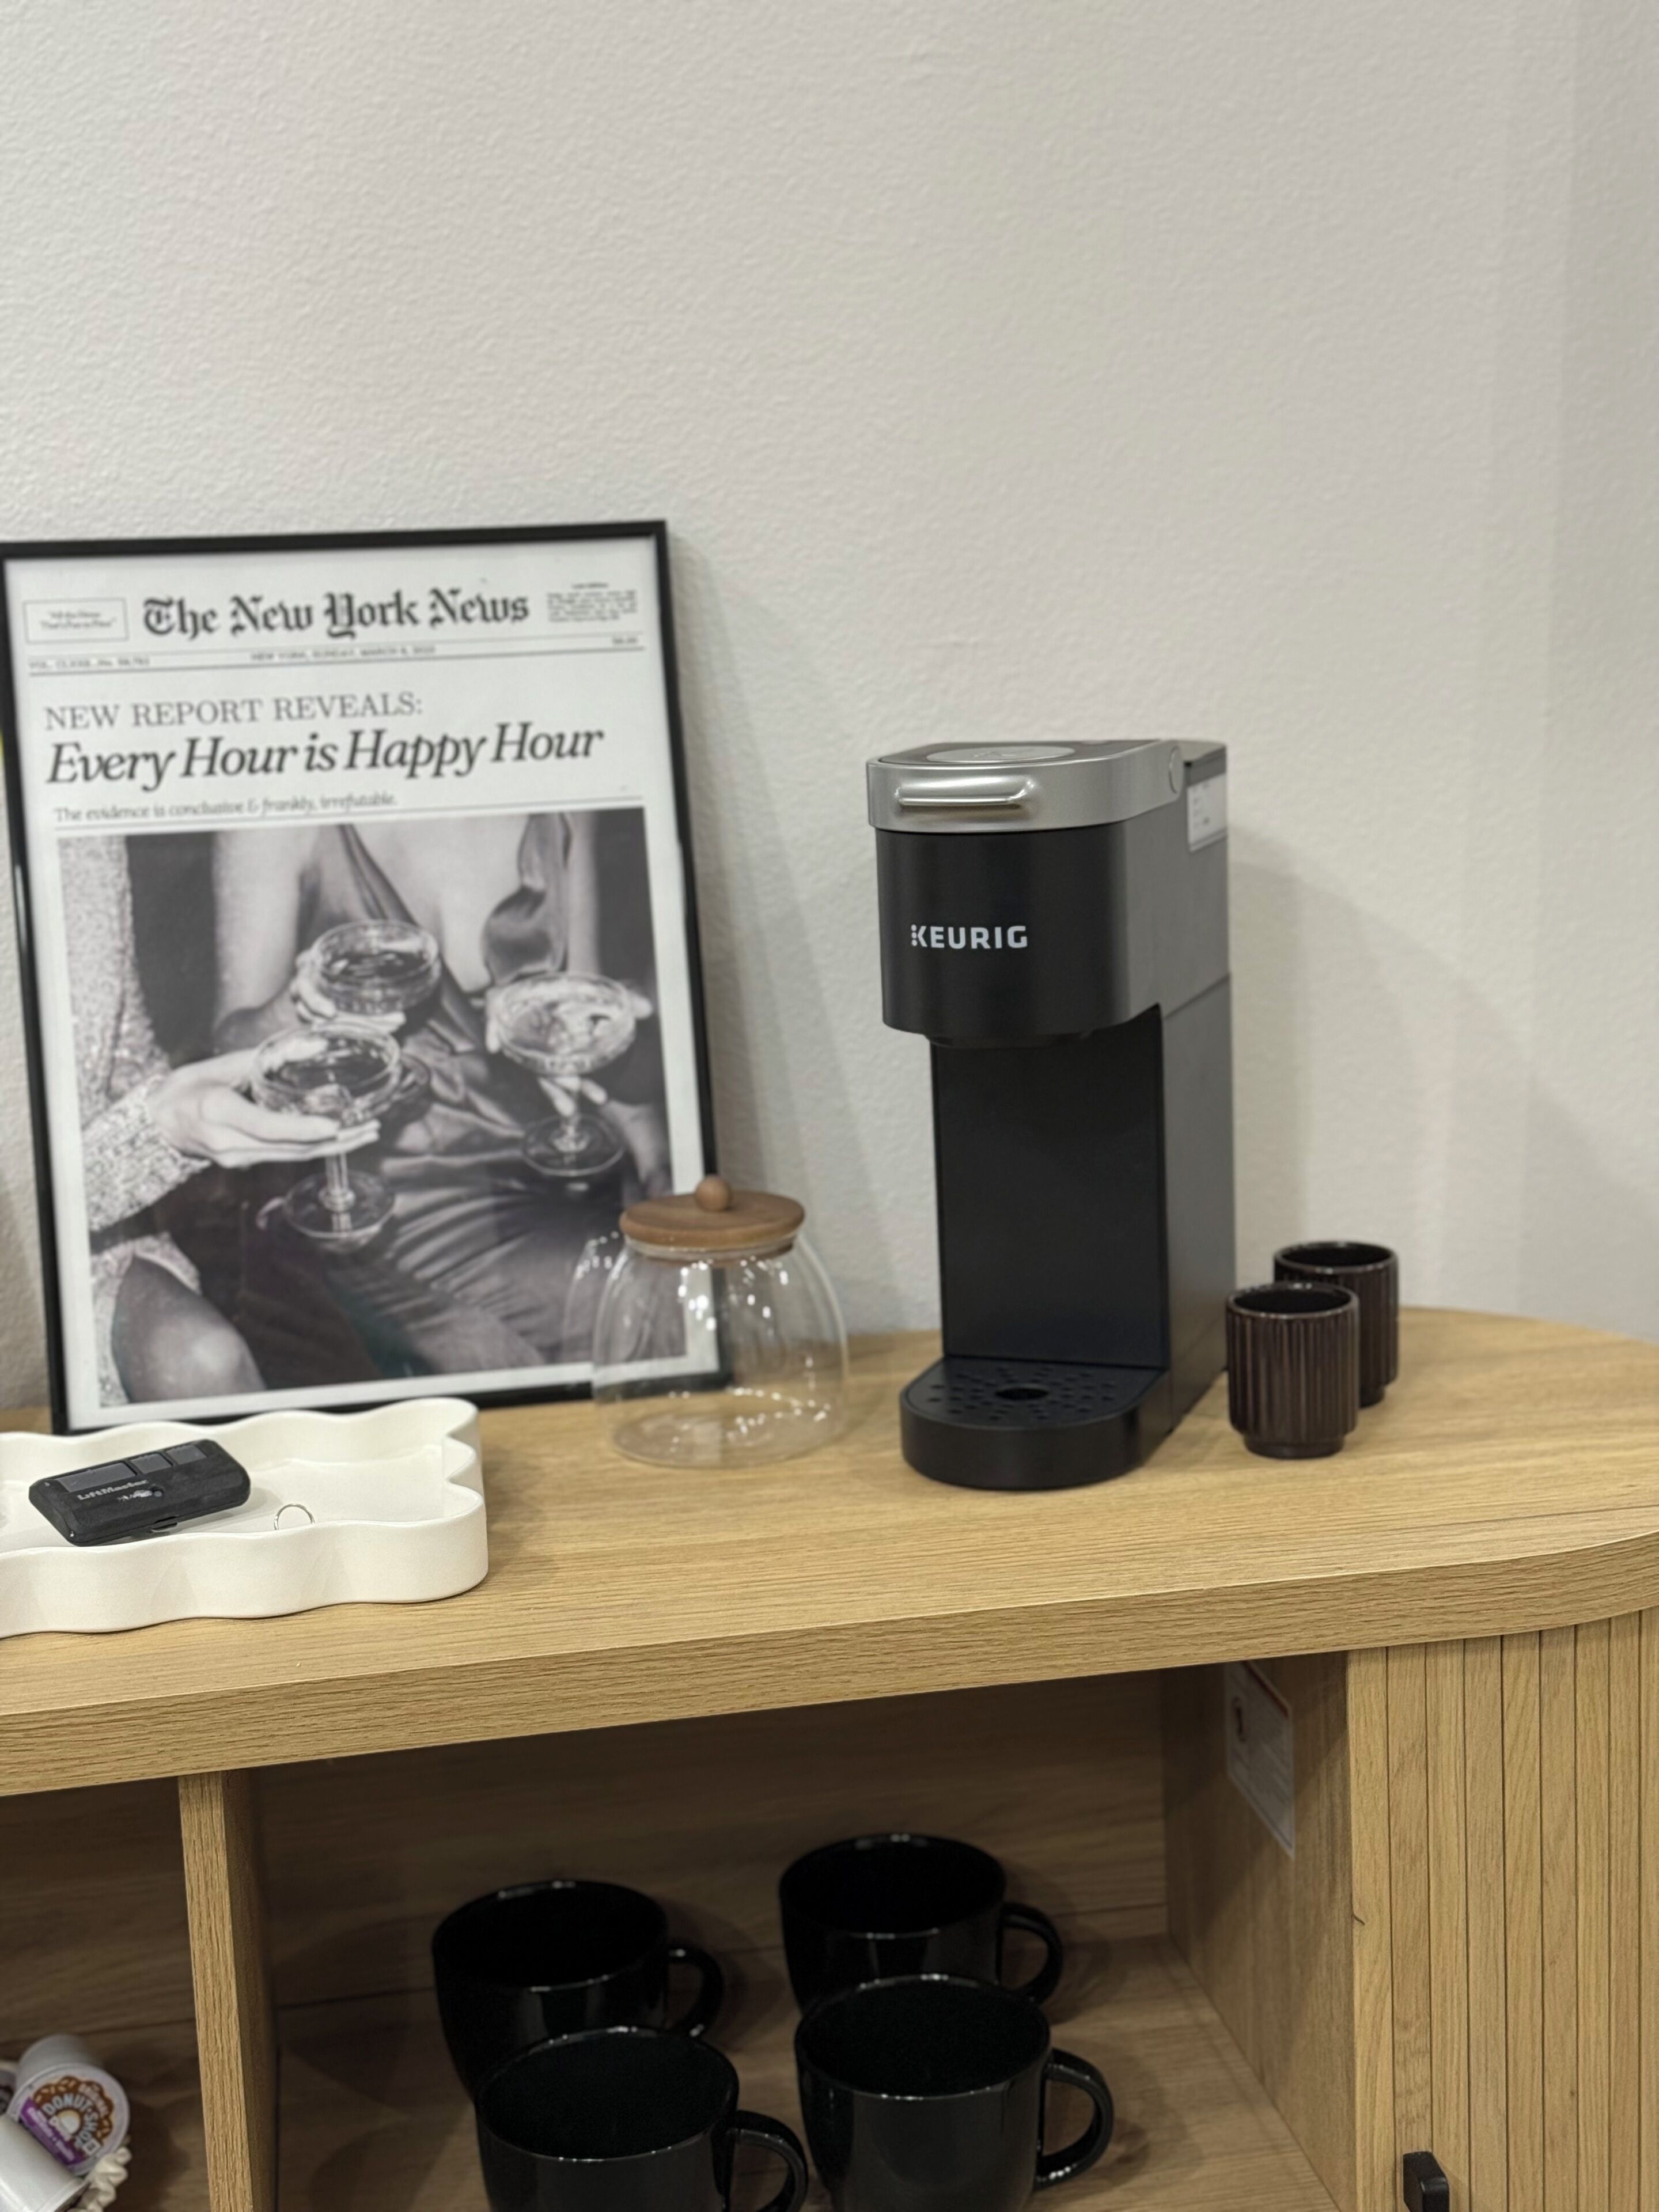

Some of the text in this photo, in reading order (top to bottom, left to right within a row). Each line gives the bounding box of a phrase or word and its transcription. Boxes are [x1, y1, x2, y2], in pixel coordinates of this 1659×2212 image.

[143, 597, 217, 639] The
[230, 595, 312, 635] New
[324, 589, 419, 639] York
[429, 588, 529, 628] News
[44, 691, 423, 730] NEW REPORT REVEALS:
[46, 721, 605, 793] Every Hour is Happy Hour
[55, 806, 82, 821] The
[86, 804, 149, 821] evidence
[911, 925, 1028, 949] KEURIG
